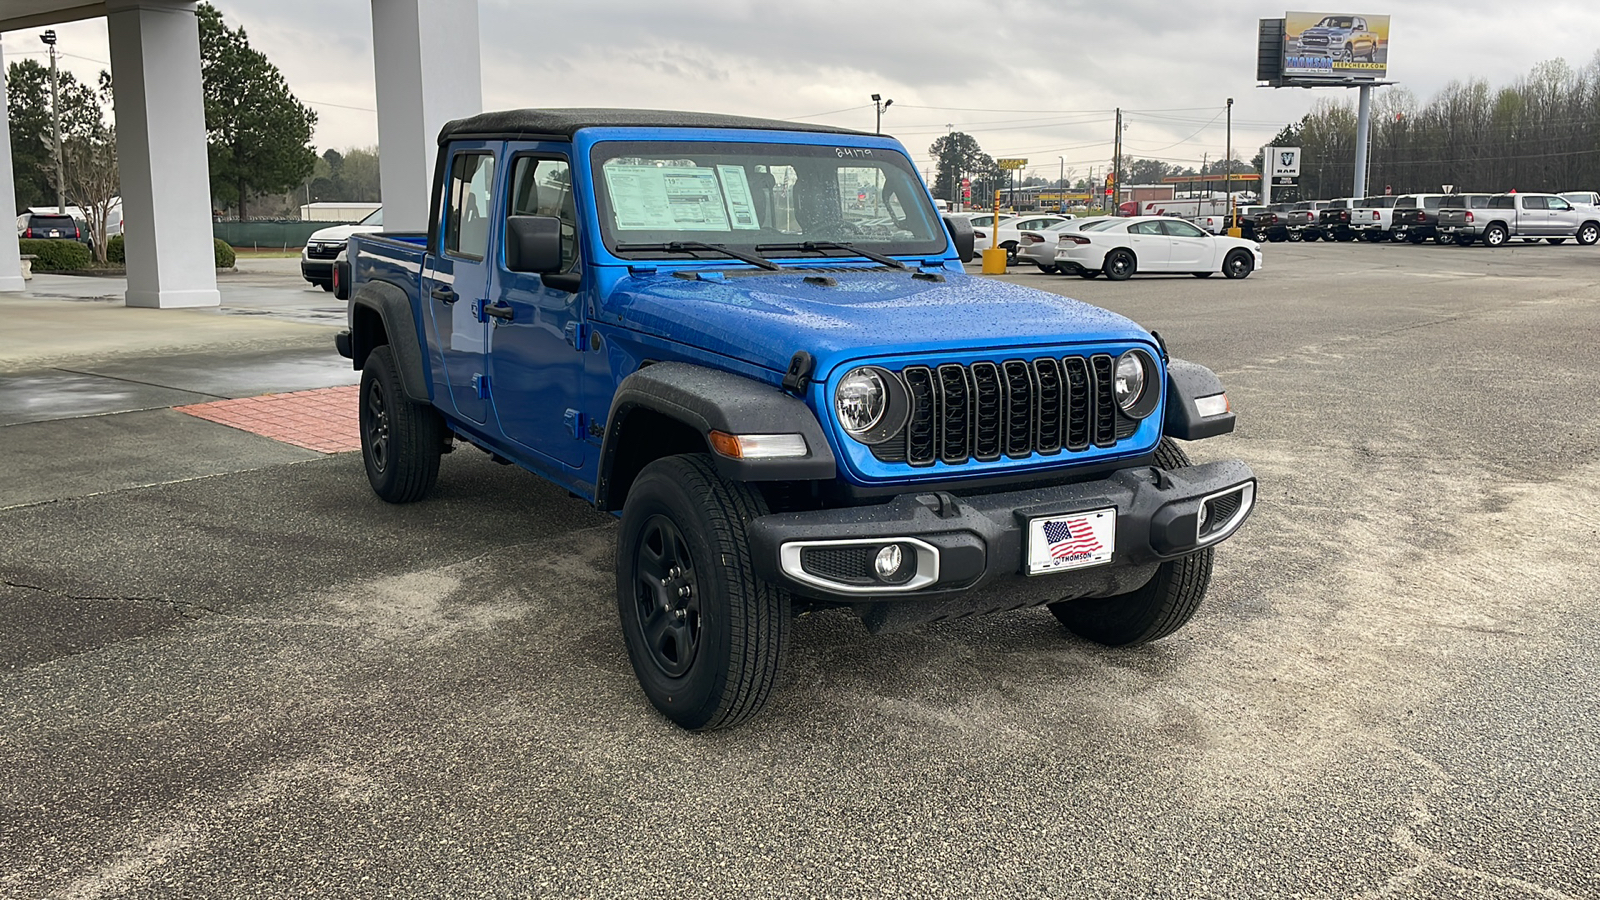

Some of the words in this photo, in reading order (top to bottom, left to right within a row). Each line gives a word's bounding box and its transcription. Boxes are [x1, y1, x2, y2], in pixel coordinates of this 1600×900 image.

[1286, 56, 1333, 68] THOMSON
[835, 148, 873, 158] 24179
[1061, 553, 1091, 562] THOMSON
